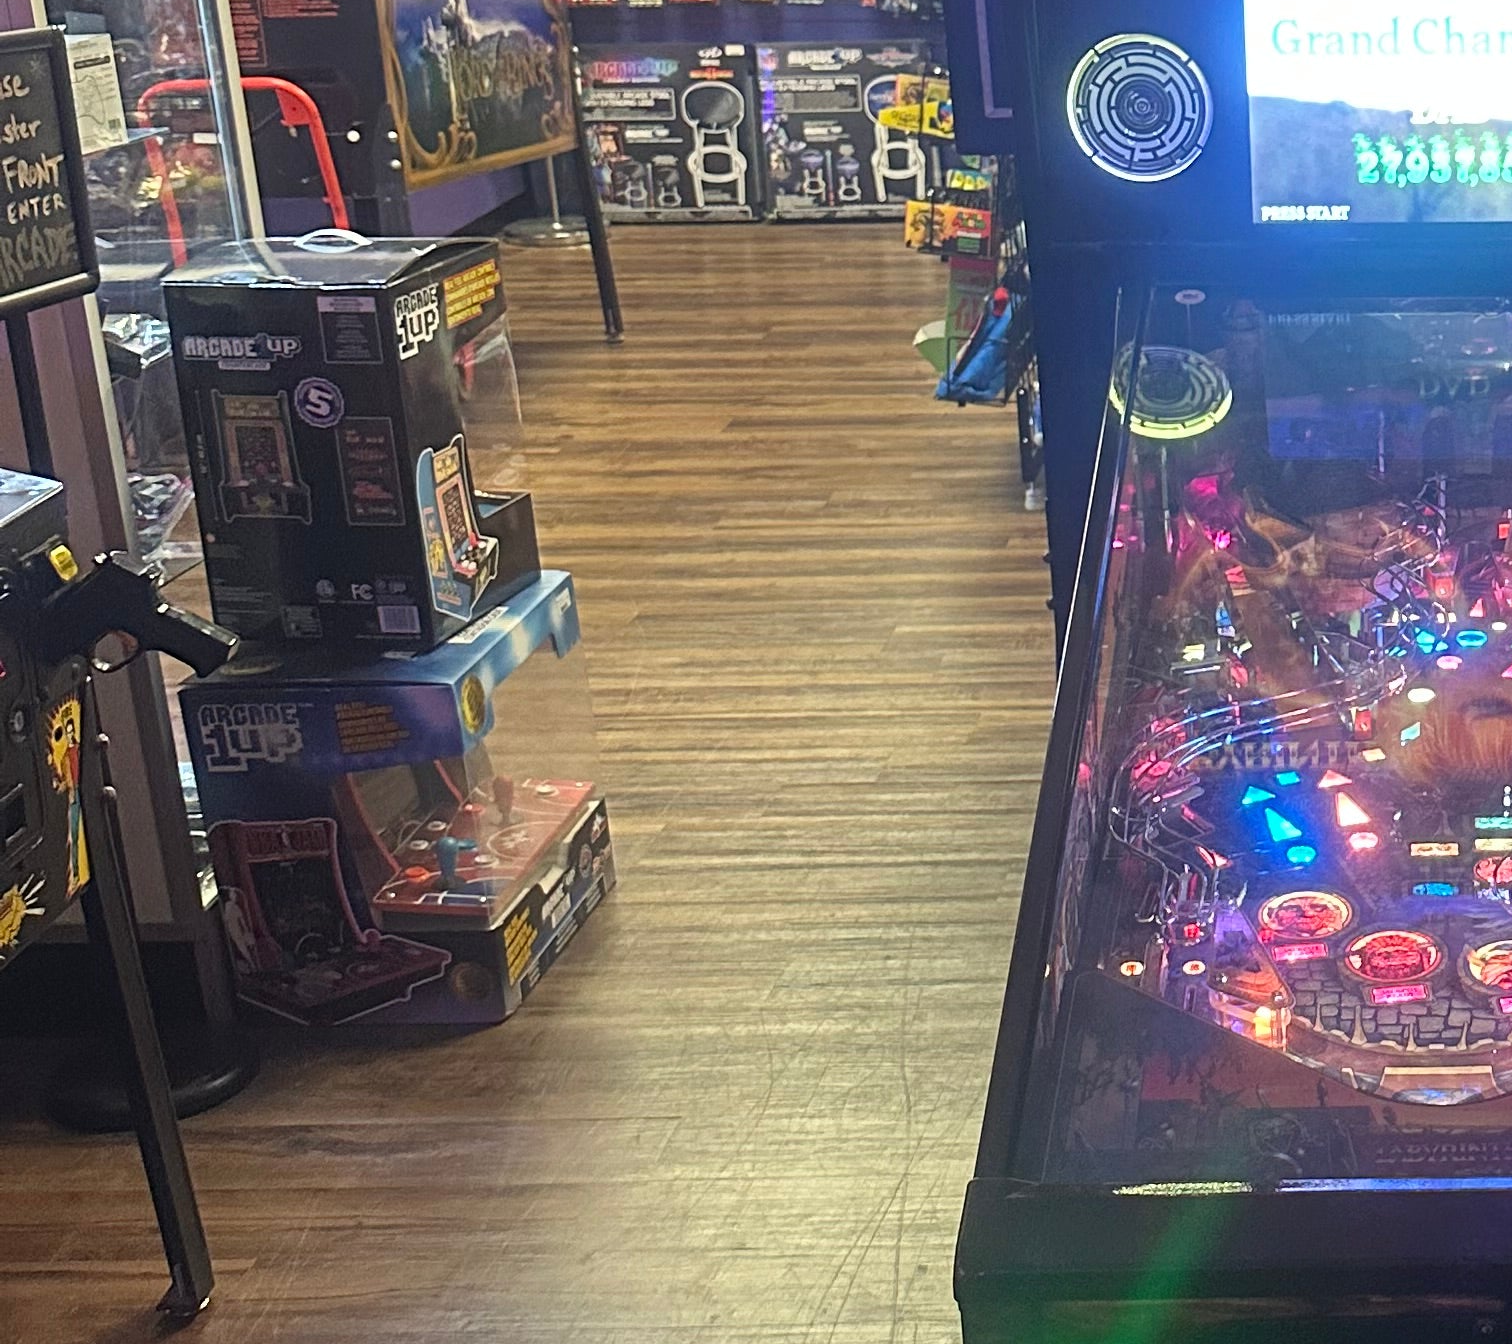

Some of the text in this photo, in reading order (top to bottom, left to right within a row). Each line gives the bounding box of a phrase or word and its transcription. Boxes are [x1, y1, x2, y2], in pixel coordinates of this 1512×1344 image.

[1272, 16, 1400, 56] Grand
[3, 152, 65, 194] FRONT
[8, 193, 67, 225] ENTER
[1261, 205, 1350, 222] PRESS START
[396, 285, 438, 319] ARCADE
[183, 337, 259, 358] ARCADE
[399, 308, 438, 356] 1UP
[200, 705, 299, 726] ARCADE
